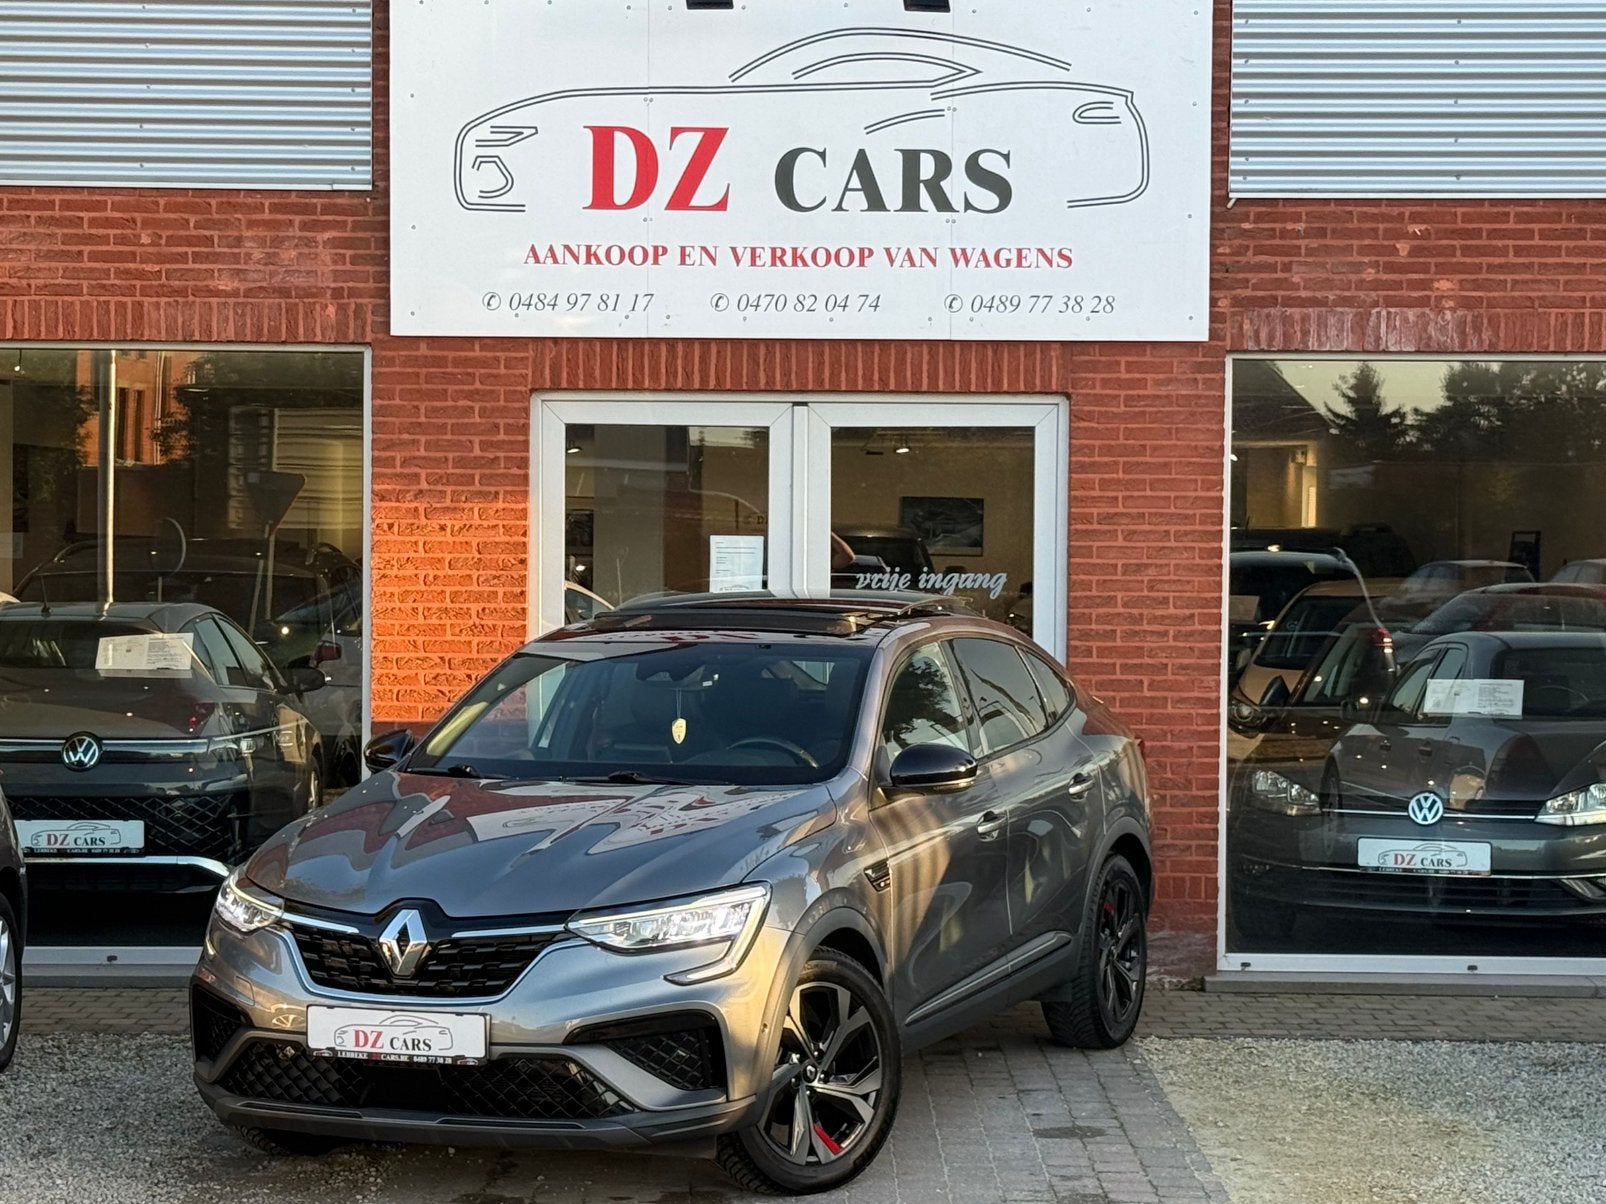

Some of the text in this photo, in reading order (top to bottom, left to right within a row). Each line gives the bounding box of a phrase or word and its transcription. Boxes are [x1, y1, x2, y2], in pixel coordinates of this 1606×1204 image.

[582, 125, 1014, 214] DZ CARS
[524, 243, 1074, 269] AANKOOP EN VERKOOP VAN WAGENS
[508, 293, 655, 312] 0484 97 81 17
[736, 294, 882, 312] 0470 82 04 74
[970, 295, 1116, 314] 0489 77 38 28
[855, 566, 1007, 599] vrije ingang
[1408, 792, 1444, 825] VW
[47, 834, 106, 847] DZ CARS
[1394, 853, 1452, 868] DZ CARS
[353, 1030, 432, 1051] DZ CARS
